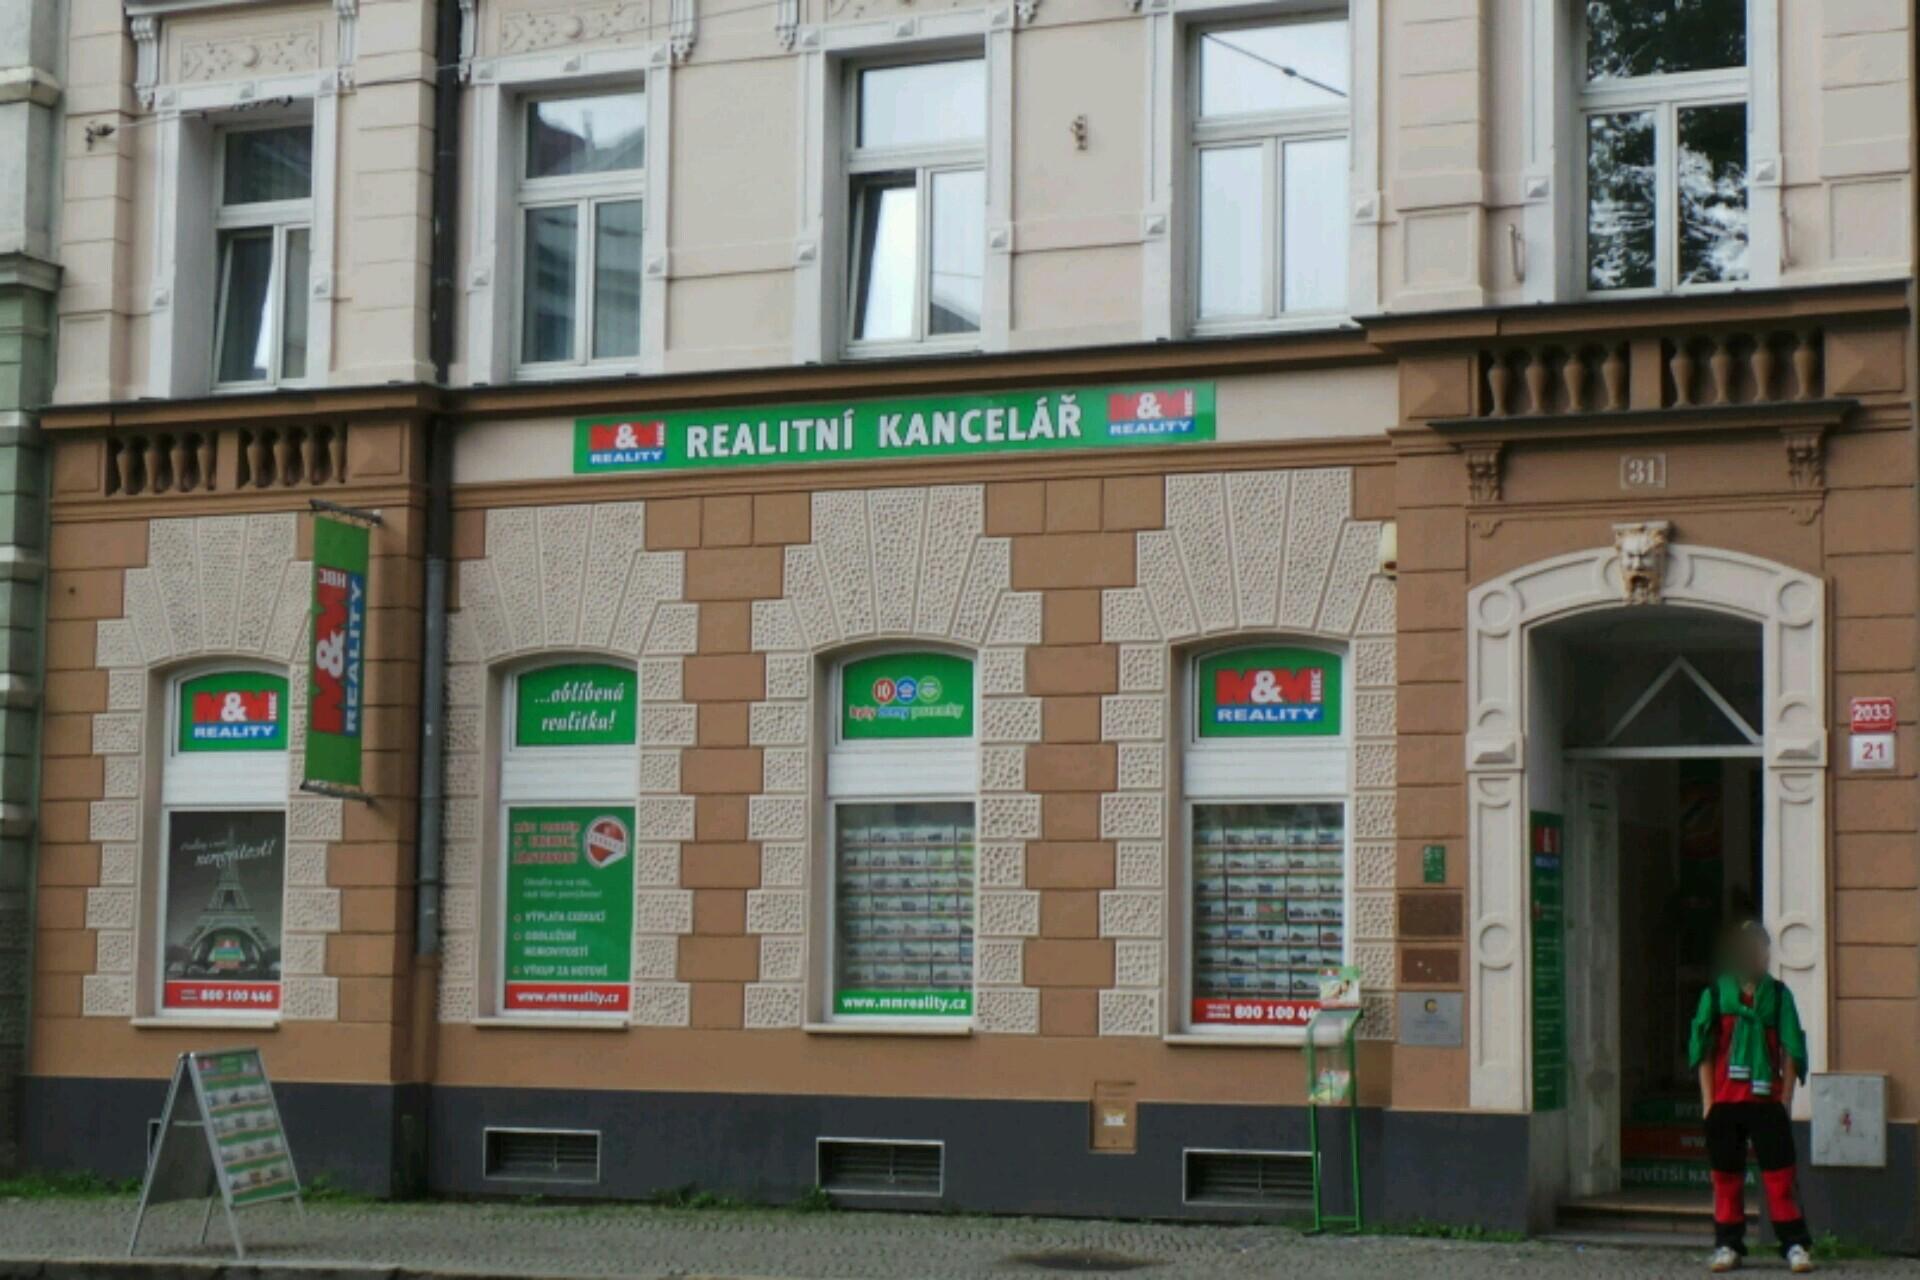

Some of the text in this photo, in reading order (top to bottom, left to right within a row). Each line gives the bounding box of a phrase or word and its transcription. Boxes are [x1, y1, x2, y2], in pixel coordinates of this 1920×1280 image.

[1109, 389, 1186, 421] M&M
[686, 394, 1082, 459] REALITNÍ KANCELÁŘ
[1109, 420, 1192, 436] REALITY
[590, 421, 659, 452] M&M
[591, 450, 664, 464] REALITY
[1629, 458, 1655, 484] 31
[346, 580, 362, 733] REALITY
[1215, 667, 1311, 704] M&M
[193, 691, 269, 722] M&M
[1216, 707, 1319, 722] REALITY
[1852, 703, 1891, 721] 2033
[194, 725, 275, 739] REALITY
[1863, 742, 1884, 760] 21
[226, 988, 249, 1002] 100
[841, 994, 968, 1013] www.mmreality.cz
[1234, 1004, 1263, 1019] 800
[1266, 1005, 1295, 1020] 100
